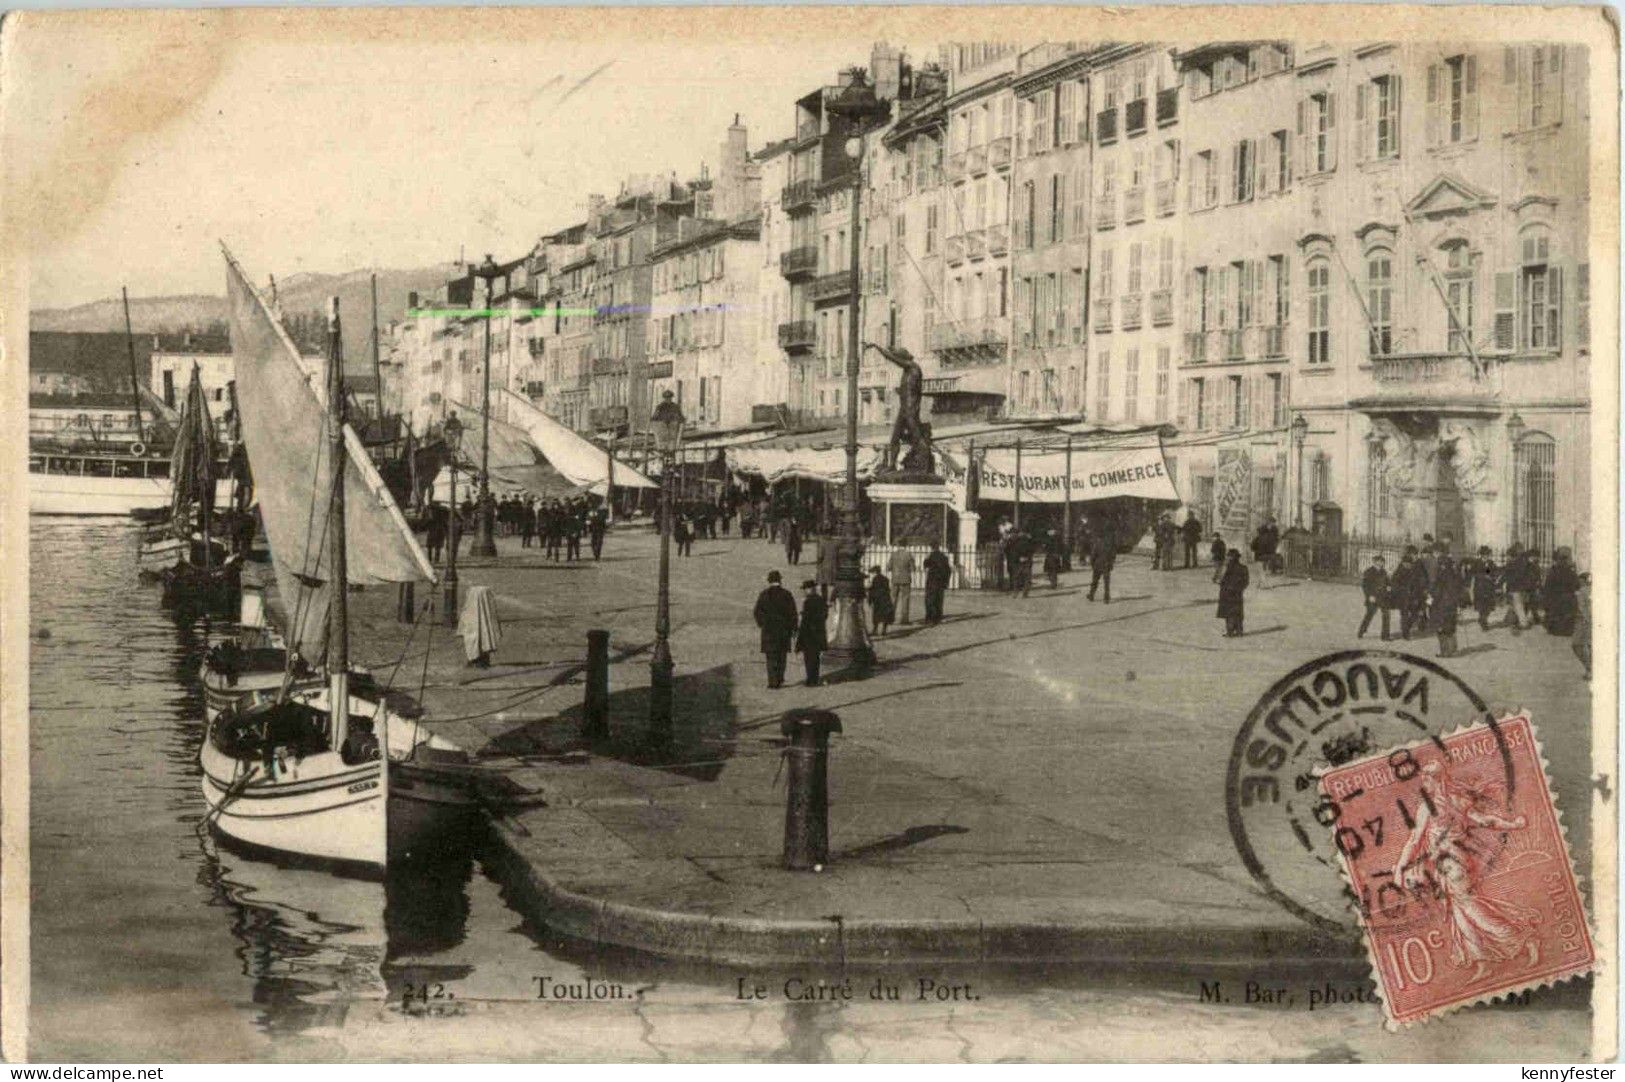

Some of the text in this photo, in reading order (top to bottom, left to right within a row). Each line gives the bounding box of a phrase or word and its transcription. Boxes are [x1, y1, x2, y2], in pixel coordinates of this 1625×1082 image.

[981, 462, 1164, 491] RESTAURANT du COMMERCE
[1242, 663, 1429, 807] VAUCLUSE
